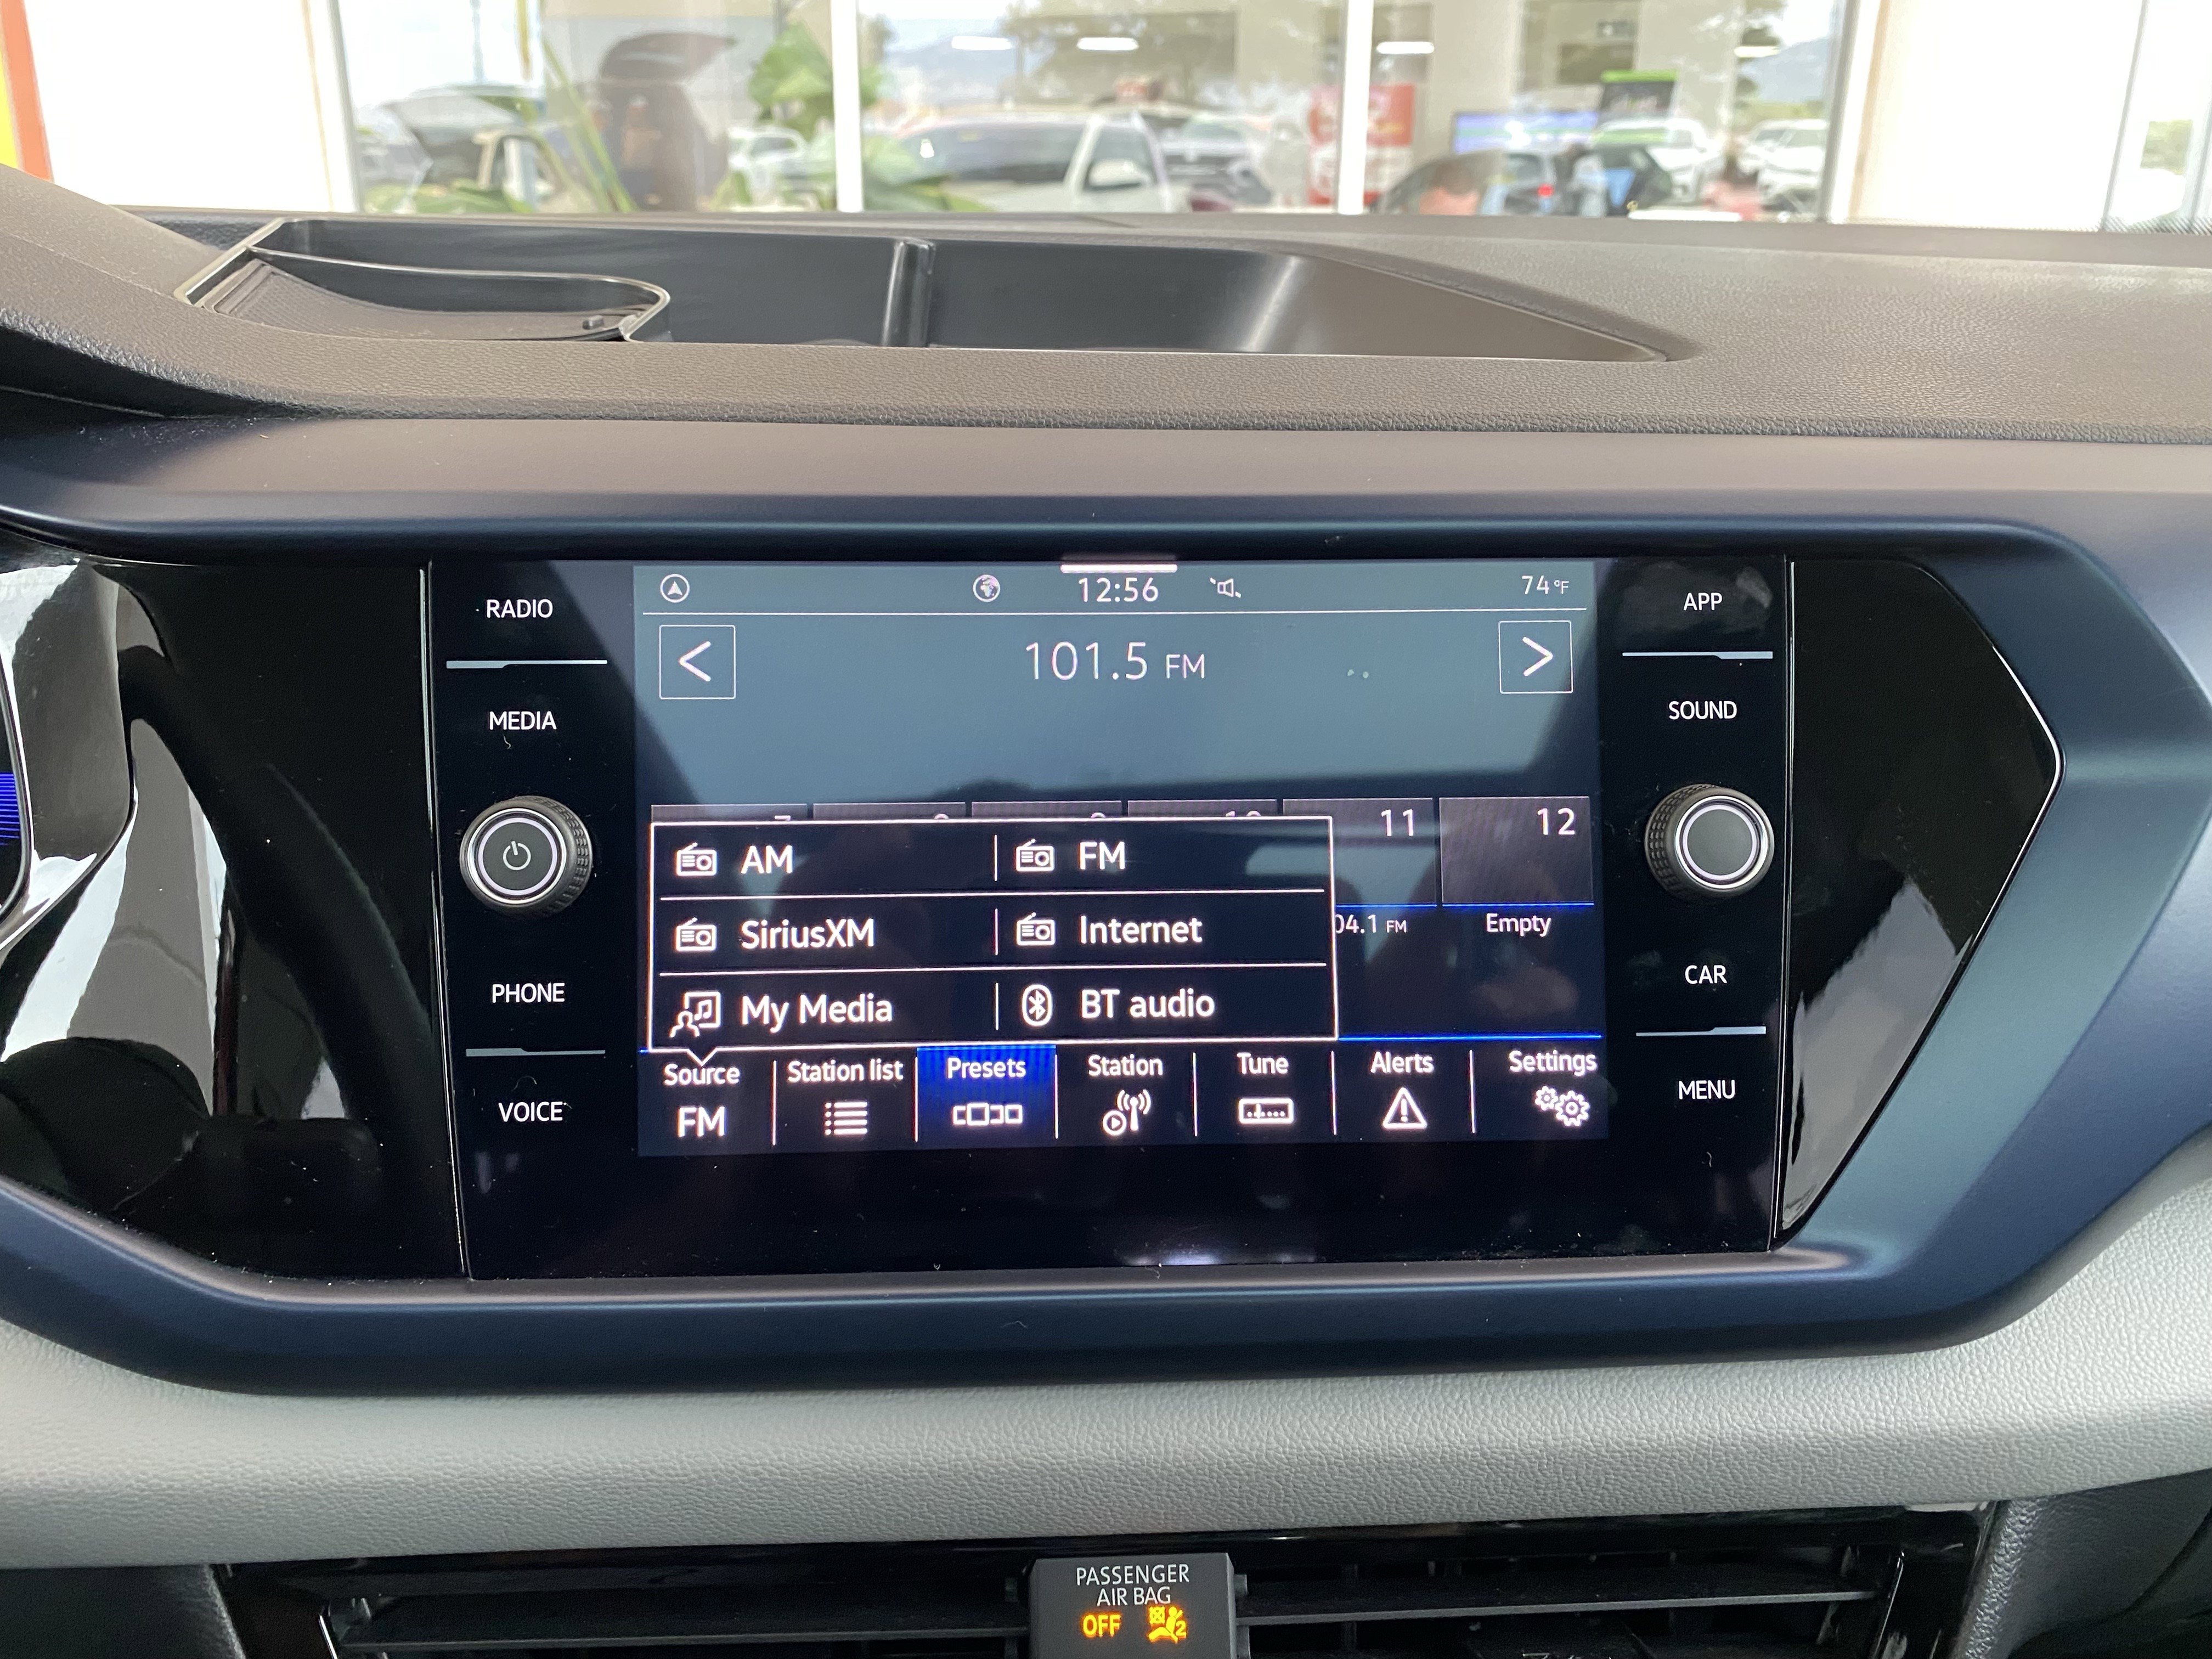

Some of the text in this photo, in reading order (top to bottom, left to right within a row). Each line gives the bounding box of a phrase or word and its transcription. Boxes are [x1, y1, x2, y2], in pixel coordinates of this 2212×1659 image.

[1078, 577, 1158, 602] 12:56
[487, 599, 553, 618] RADIO
[1683, 592, 1723, 611] APP
[1026, 641, 1205, 680] 101.5 FM
[489, 710, 557, 730] MEDIA
[1668, 701, 1737, 720] SOUND
[1381, 809, 1414, 837] 11
[1537, 808, 1575, 836] 12
[741, 845, 793, 874] AM
[1080, 841, 1125, 870] FM
[741, 918, 874, 949] SiriusXM
[1081, 915, 1203, 944] Internet
[1386, 919, 1407, 933] FM
[1486, 913, 1551, 938] Empty
[1685, 964, 1728, 985] CAR
[492, 983, 565, 1003] PHONE
[1082, 988, 1215, 1019] BT audio
[742, 992, 893, 1034] My Media
[787, 1058, 904, 1083] Station list
[947, 1057, 1026, 1079] Presets
[1088, 1053, 1163, 1077] Station
[1237, 1052, 1289, 1075] Tune
[1370, 1051, 1435, 1074] Alerts
[1509, 1049, 1598, 1077] Settings
[664, 1064, 741, 1086] Source
[1678, 1079, 1735, 1100] MENU
[498, 1101, 563, 1122] VOICE
[678, 1105, 725, 1138] FM
[1076, 1564, 1189, 1585] PASSENGER
[1097, 1586, 1171, 1607] AIR BAG
[1083, 1614, 1121, 1637] OFF
